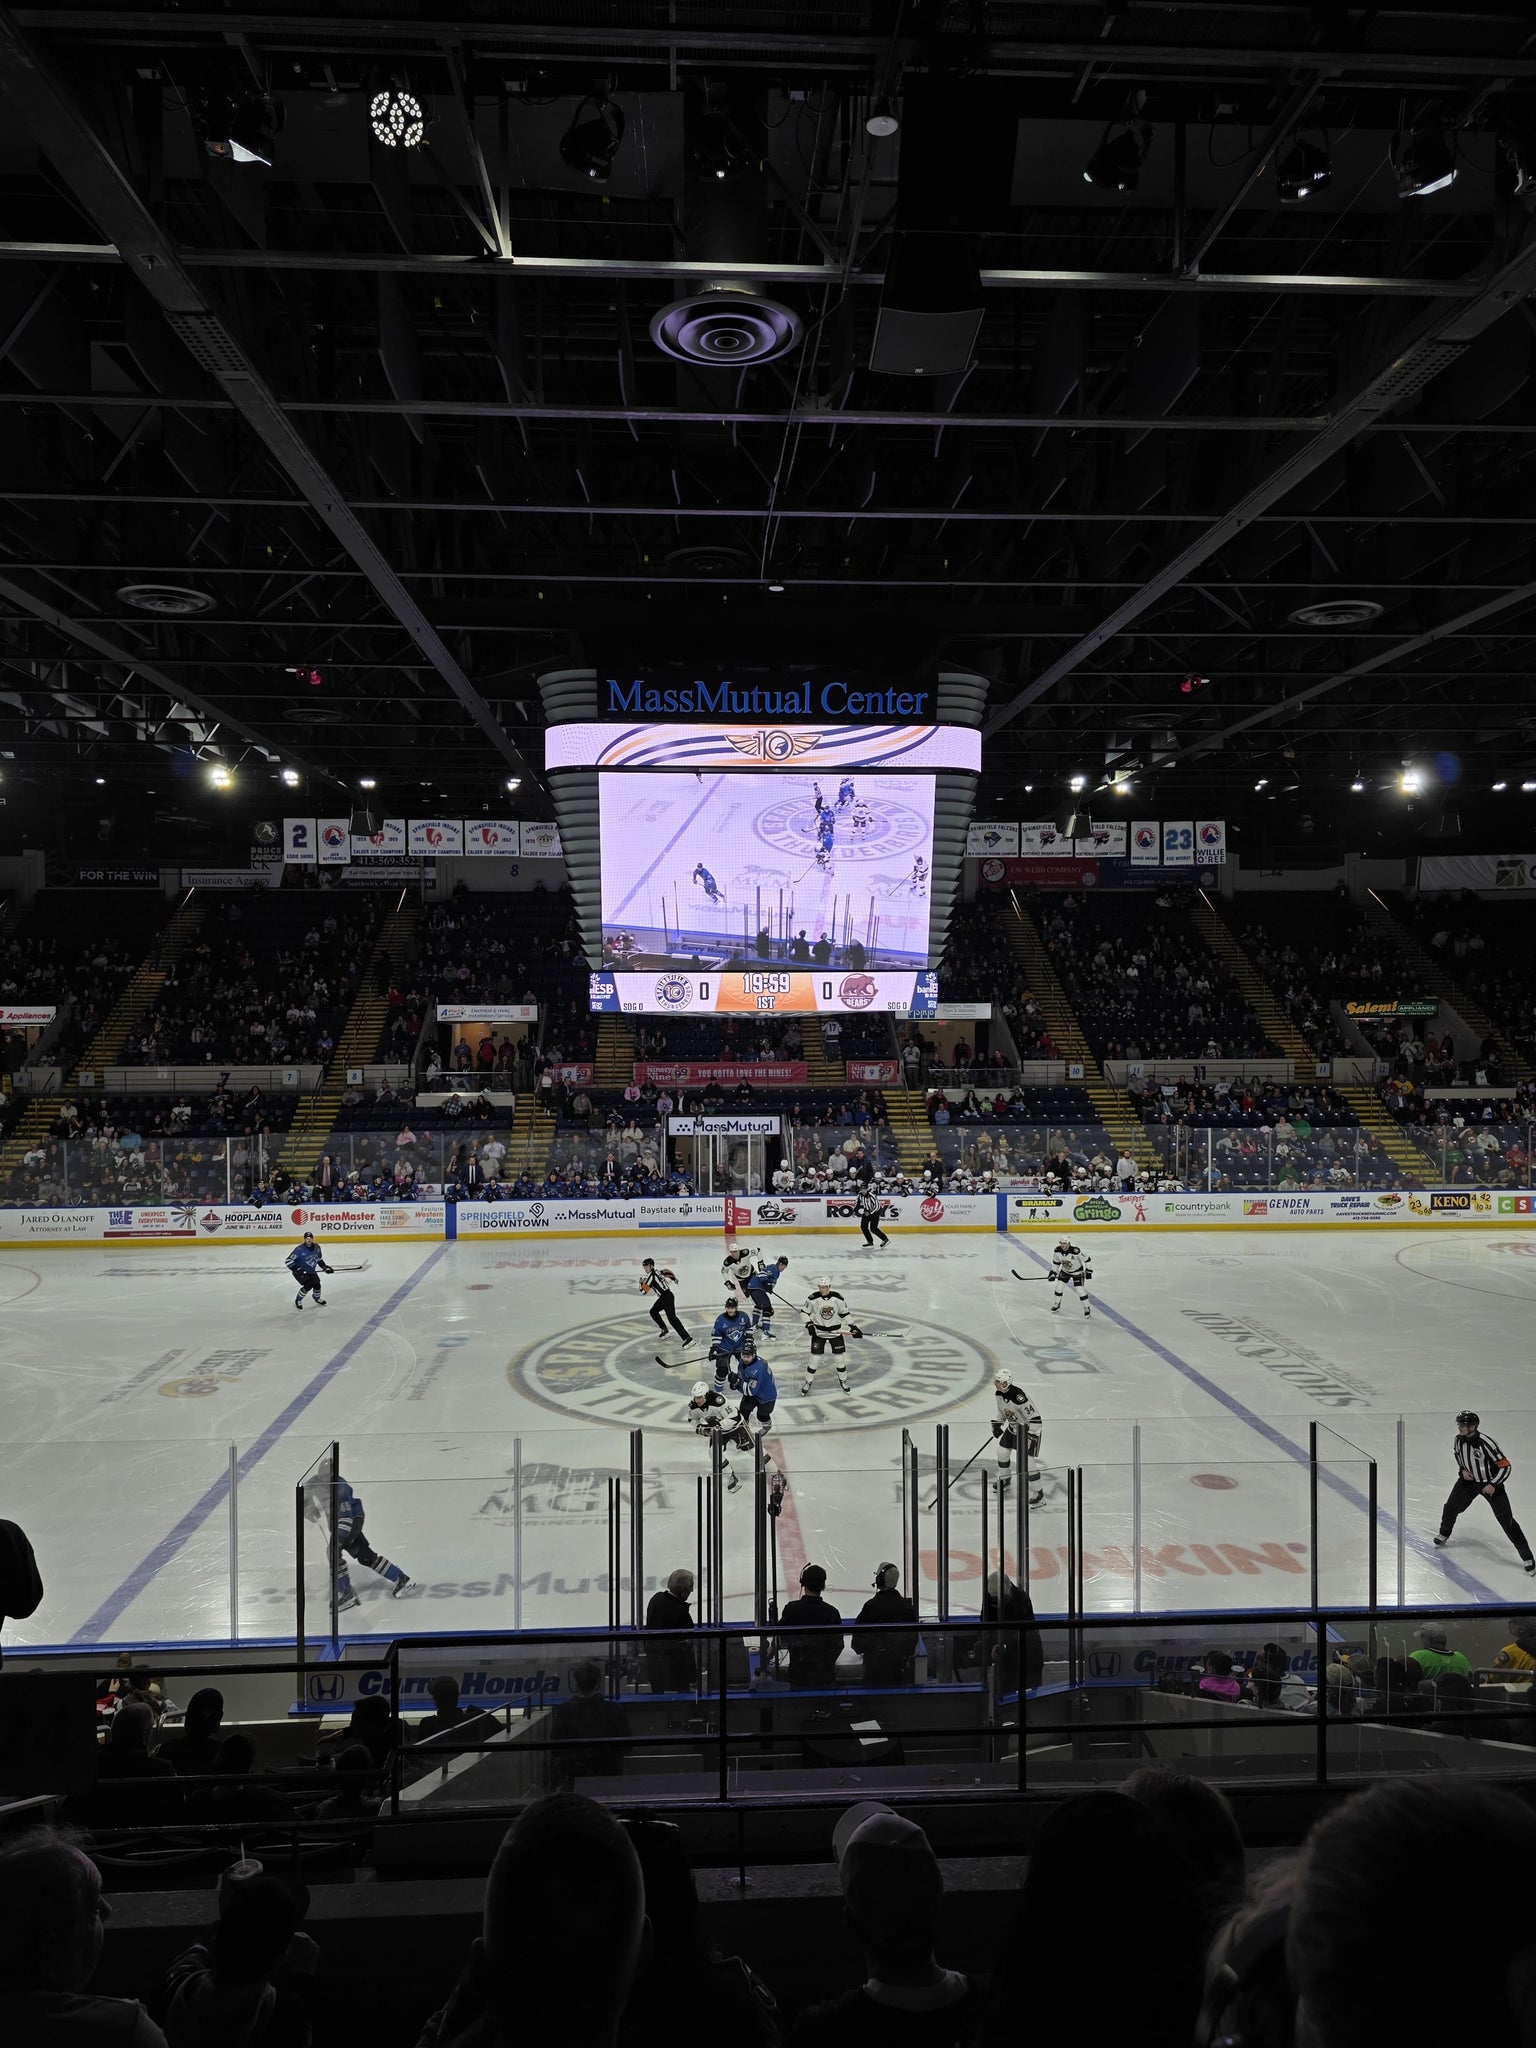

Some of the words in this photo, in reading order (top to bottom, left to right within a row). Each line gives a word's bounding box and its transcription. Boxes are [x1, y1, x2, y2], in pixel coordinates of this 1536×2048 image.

[607, 680, 813, 714] MassMutual
[819, 681, 930, 715] Center
[412, 822, 441, 834] SPRINGFIELD
[442, 822, 460, 835] INDIANS
[468, 822, 497, 834] SPRINGFIELD
[498, 822, 516, 835] INDIANS
[293, 824, 308, 849] 2
[1165, 829, 1192, 850] 23
[1197, 848, 1225, 856] WILLIE
[250, 854, 282, 862] LANDON
[80, 871, 102, 881] FOR
[107, 871, 131, 881] THE
[133, 871, 158, 881] WIN
[511, 865, 519, 877] 8
[188, 876, 233, 885] Insurance
[743, 973, 791, 993] 19:59
[700, 982, 710, 1001] 0
[822, 982, 832, 1000] 0
[623, 1003, 637, 1011] SOG
[757, 996, 775, 1009] 1ST
[887, 1002, 901, 1010] SOG
[1346, 1001, 1399, 1015] Salemi
[7, 1012, 52, 1021] Appliances
[698, 1069, 712, 1077] YOU
[713, 1069, 734, 1077] GOTTA
[736, 1069, 752, 1077] LOVE
[754, 1069, 767, 1077] THE
[768, 1069, 792, 1077] NINES!
[1133, 1067, 1140, 1075] 11
[1193, 1066, 1206, 1080] 11
[1319, 1065, 1326, 1073] 11
[1379, 1065, 1386, 1073] 12
[18, 1076, 24, 1084] 6
[220, 1072, 231, 1086] 7
[352, 1073, 357, 1081] 8
[693, 1120, 773, 1132] MassMutual
[1269, 1198, 1311, 1209] GENDEN
[1433, 1196, 1468, 1207] KENO
[1476, 1203, 1484, 1211] 10
[641, 1205, 676, 1215] Baystate
[696, 1204, 723, 1213] Health
[826, 1204, 900, 1218] ROCY's
[920, 1204, 935, 1215] Big
[1175, 1202, 1231, 1213] countrybank
[109, 1211, 125, 1219] THE
[109, 1218, 125, 1226] BIG
[124, 1210, 134, 1226] E
[225, 1213, 282, 1222] HOOPLANDIA
[460, 1212, 525, 1222] SPRINGFIELD
[569, 1208, 636, 1220] MassMutual
[1075, 1207, 1120, 1220] Gringo
[21, 1214, 50, 1225] JARED
[52, 1214, 96, 1223] OLANOFF
[482, 1218, 549, 1228] DOWNTOWN
[321, 1222, 342, 1231] PRO
[343, 1221, 375, 1231] Driven
[1180, 1309, 1265, 1344] SHOP
[1259, 1361, 1373, 1407] SHOT
[1024, 1405, 1035, 1415] 34
[1134, 1650, 1208, 1673] Curr
[358, 1670, 442, 1696] Curr
[460, 1669, 561, 1696] Honda
